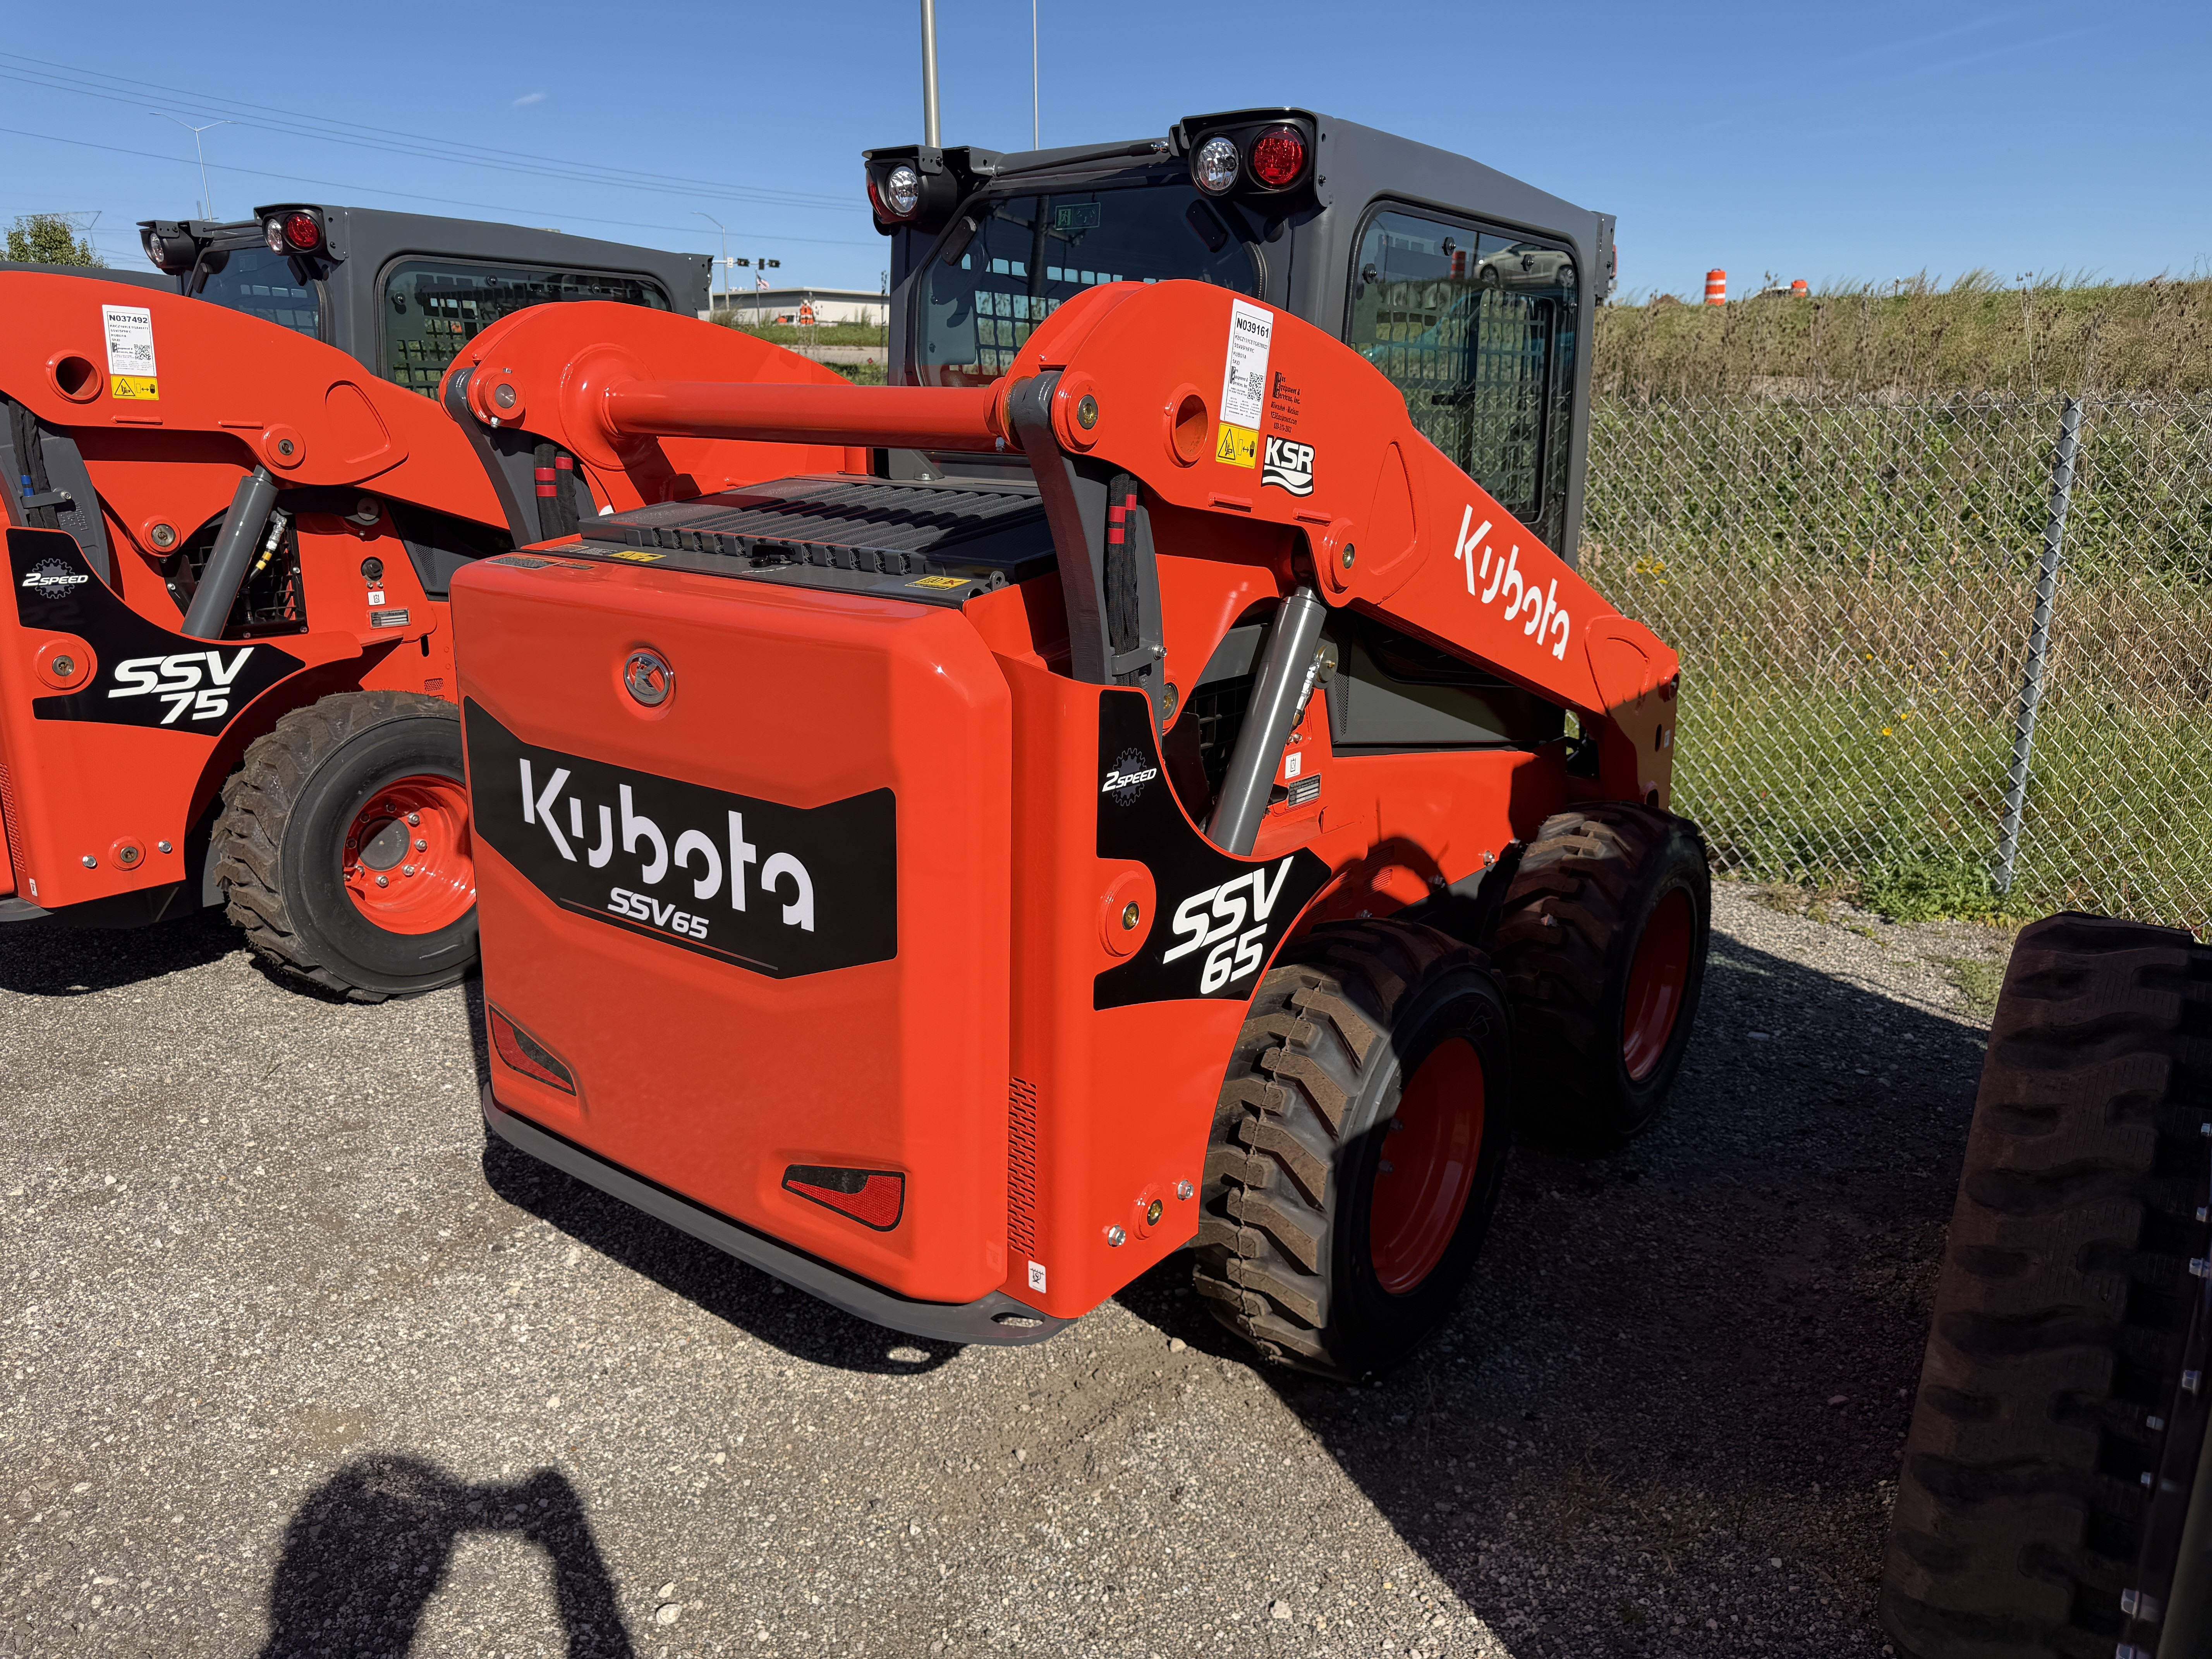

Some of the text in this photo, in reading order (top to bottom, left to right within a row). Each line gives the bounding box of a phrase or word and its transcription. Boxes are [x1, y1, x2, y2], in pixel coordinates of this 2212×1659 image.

[109, 314, 148, 323] N037492
[1237, 318, 1269, 338] N039161
[1265, 437, 1314, 473] KSR
[1454, 504, 1569, 661] Kubota
[108, 647, 254, 697] SSV
[160, 687, 230, 724] 75
[519, 758, 814, 932] Kubota
[608, 887, 709, 939] SSV65
[1163, 856, 1294, 964] SSV
[1200, 924, 1267, 994] 65
